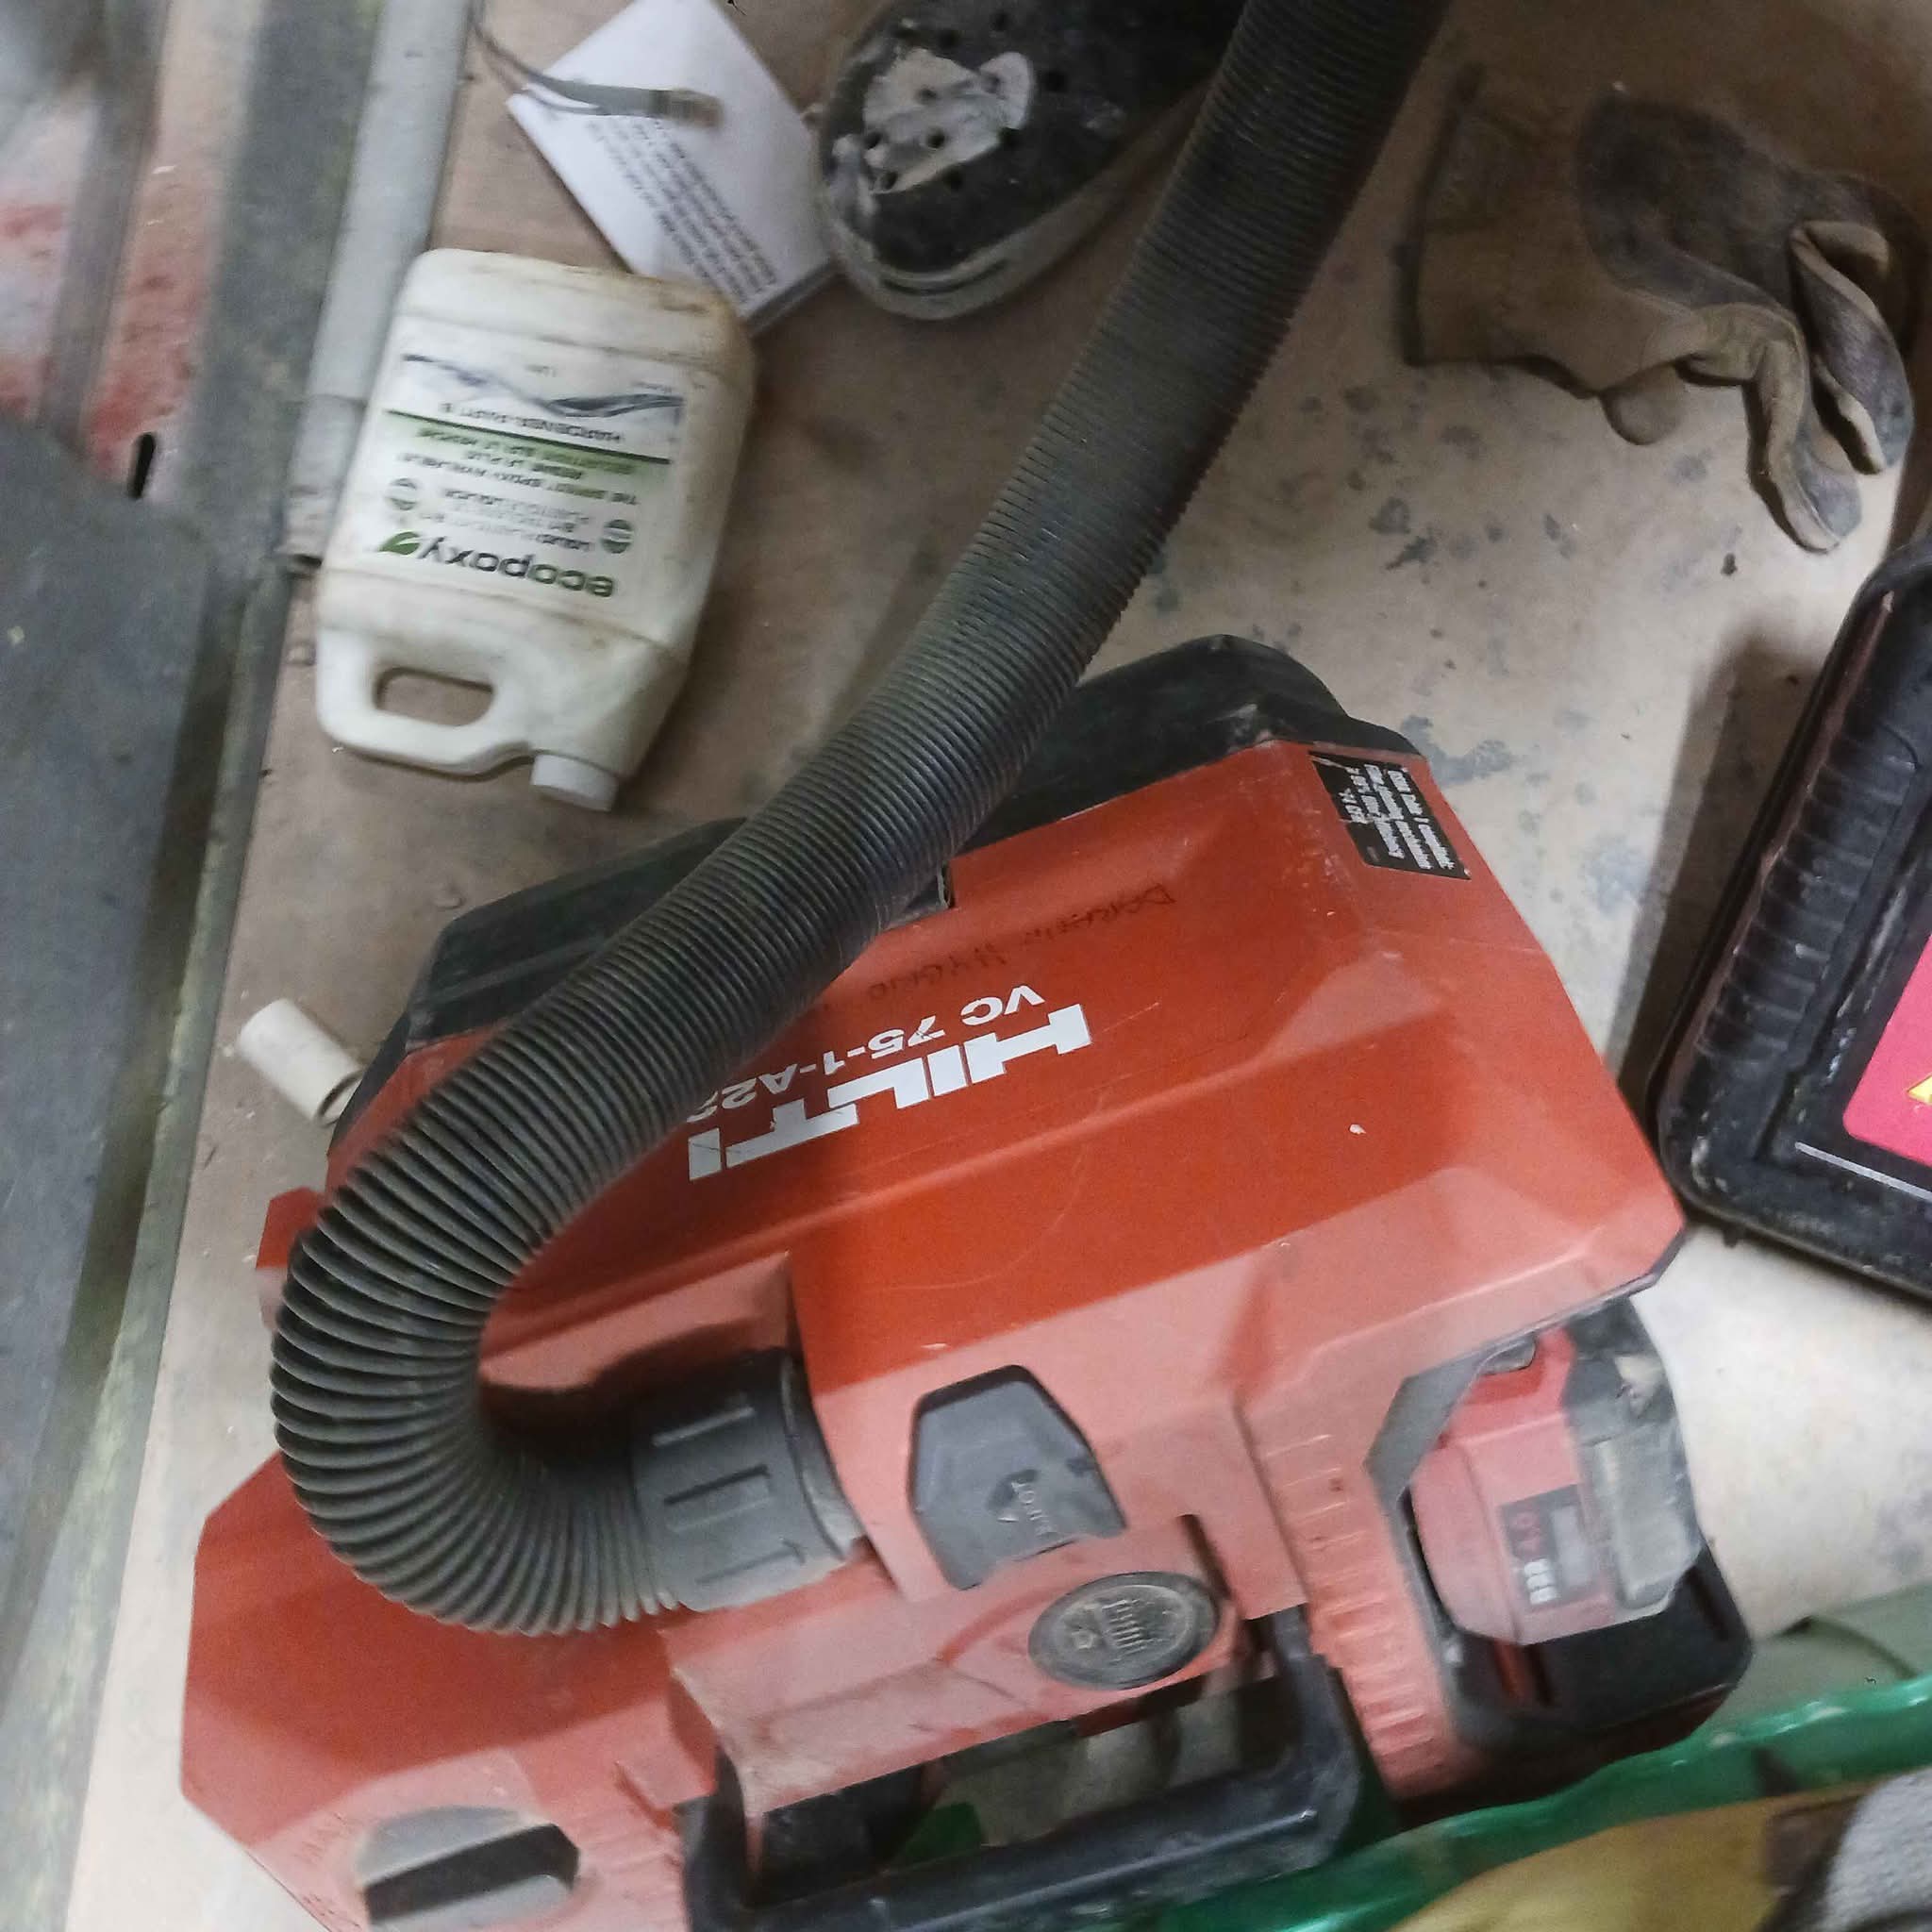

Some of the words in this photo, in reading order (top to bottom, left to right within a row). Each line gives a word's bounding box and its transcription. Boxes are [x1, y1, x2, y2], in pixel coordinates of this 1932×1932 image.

[418, 536, 613, 597] ecopoxy
[959, 985, 1045, 1026] VC
[688, 1003, 1092, 1181] HILTI
